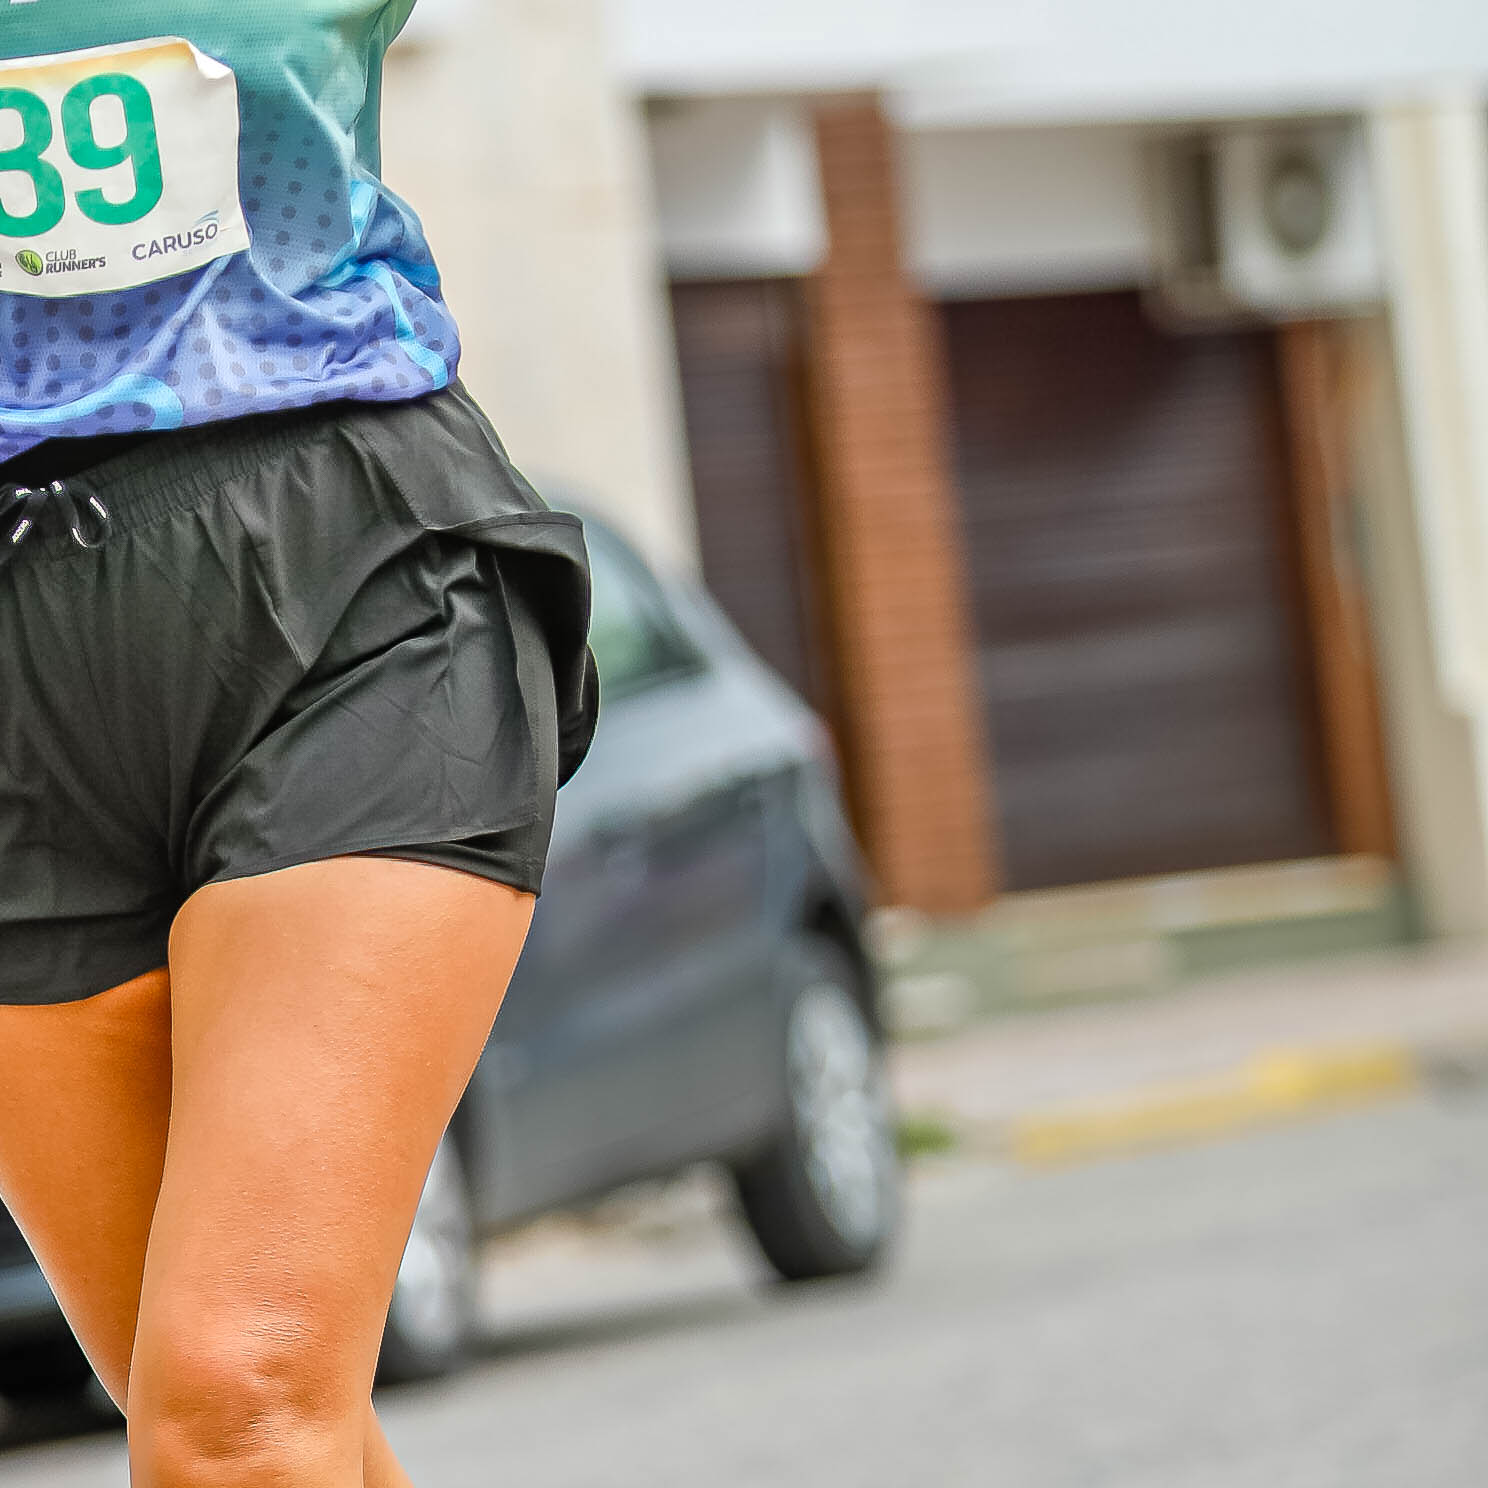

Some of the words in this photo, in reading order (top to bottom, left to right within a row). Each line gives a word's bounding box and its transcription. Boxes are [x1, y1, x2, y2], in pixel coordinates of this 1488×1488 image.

[131, 223, 218, 261] CARUSO
[45, 249, 77, 262] CLUB
[45, 256, 107, 275] RUNNER'S
